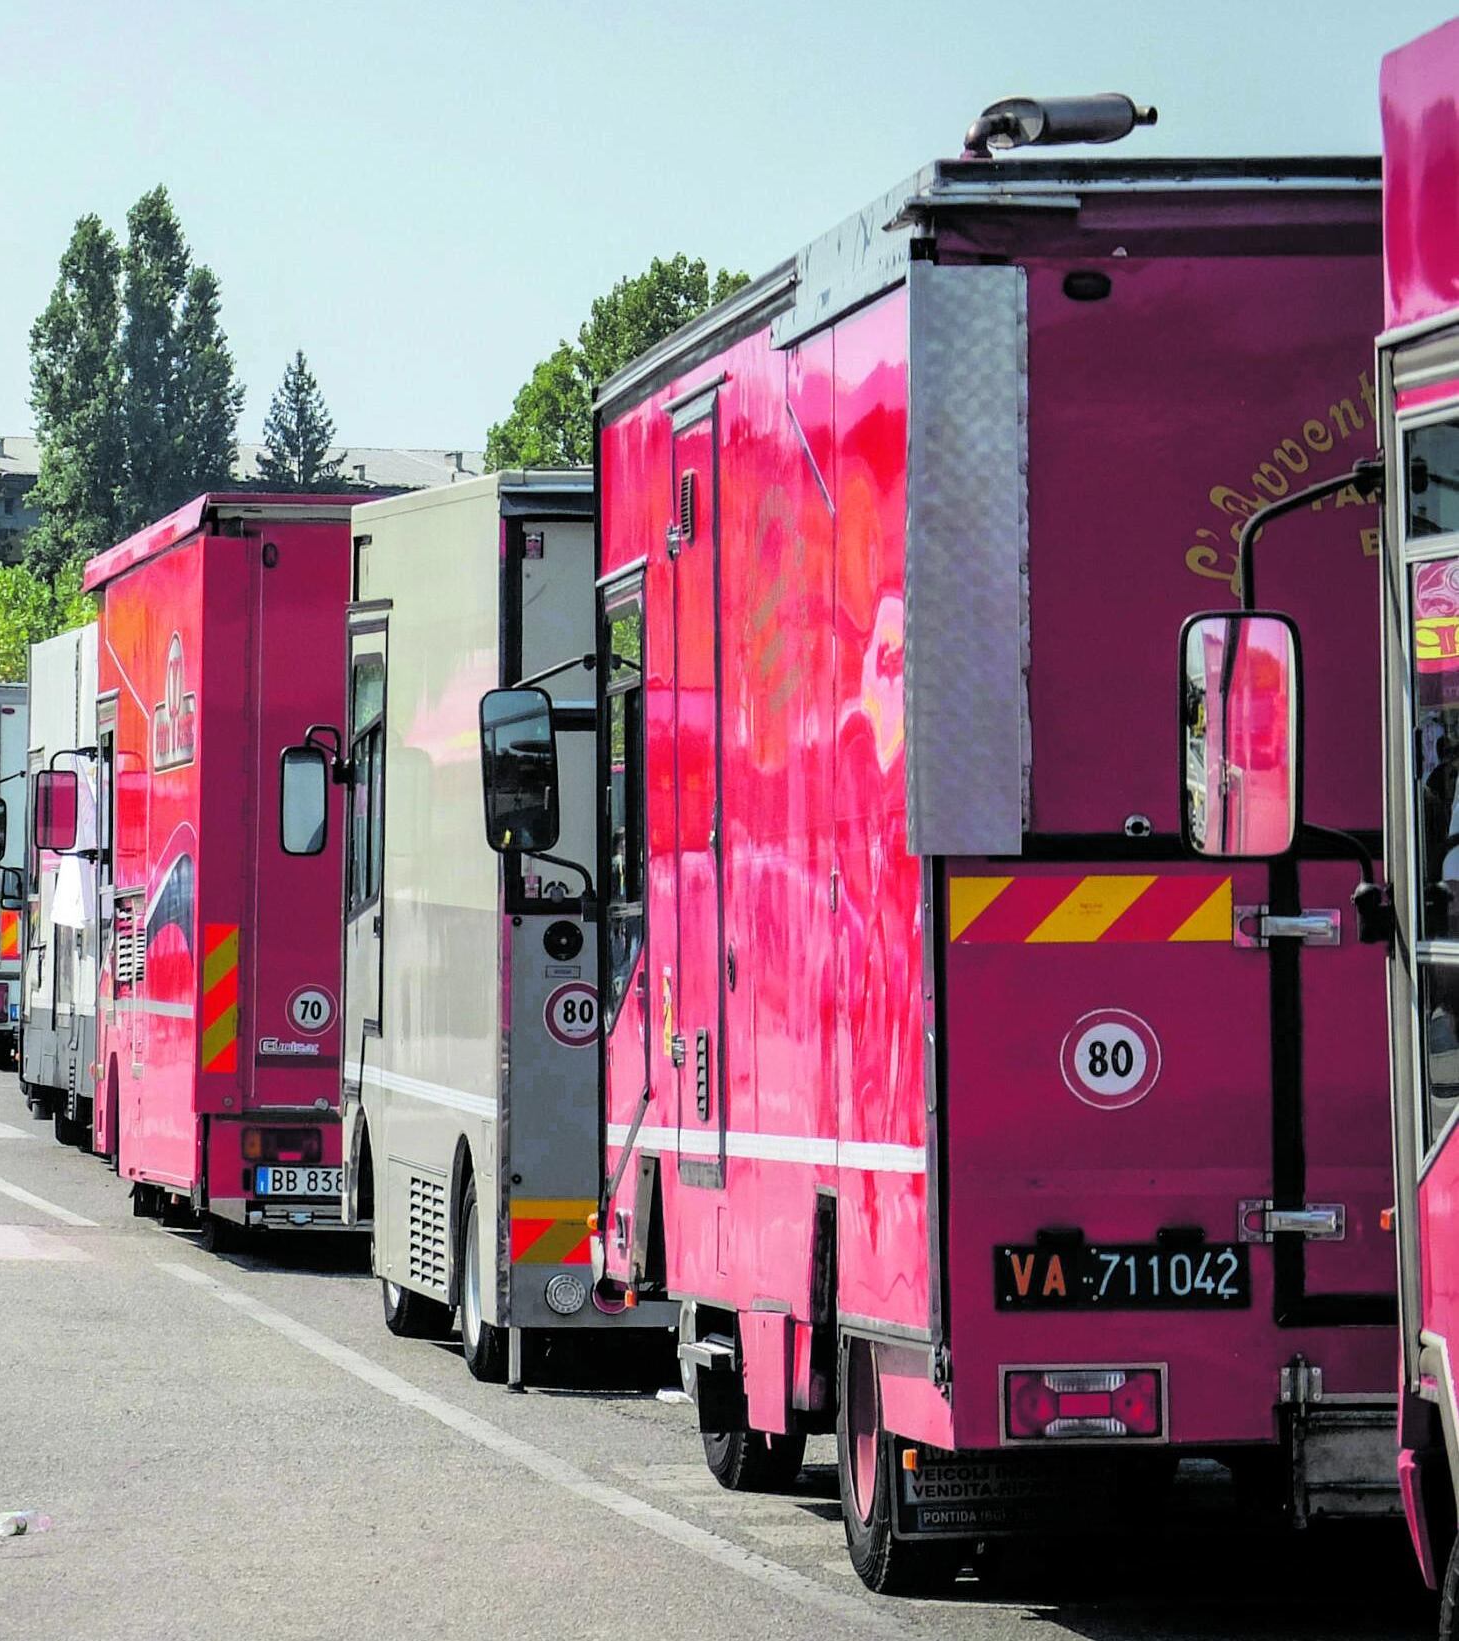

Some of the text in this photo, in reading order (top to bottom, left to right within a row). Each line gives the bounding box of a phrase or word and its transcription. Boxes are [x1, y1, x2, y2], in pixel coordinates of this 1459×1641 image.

[300, 1000, 322, 1020] 70
[563, 999, 594, 1024] 80
[1088, 1040, 1134, 1078] 80
[272, 1169, 297, 1192] BB
[1010, 1252, 1239, 1297] VA 711042
[923, 1510, 977, 1524] PONTIDA
